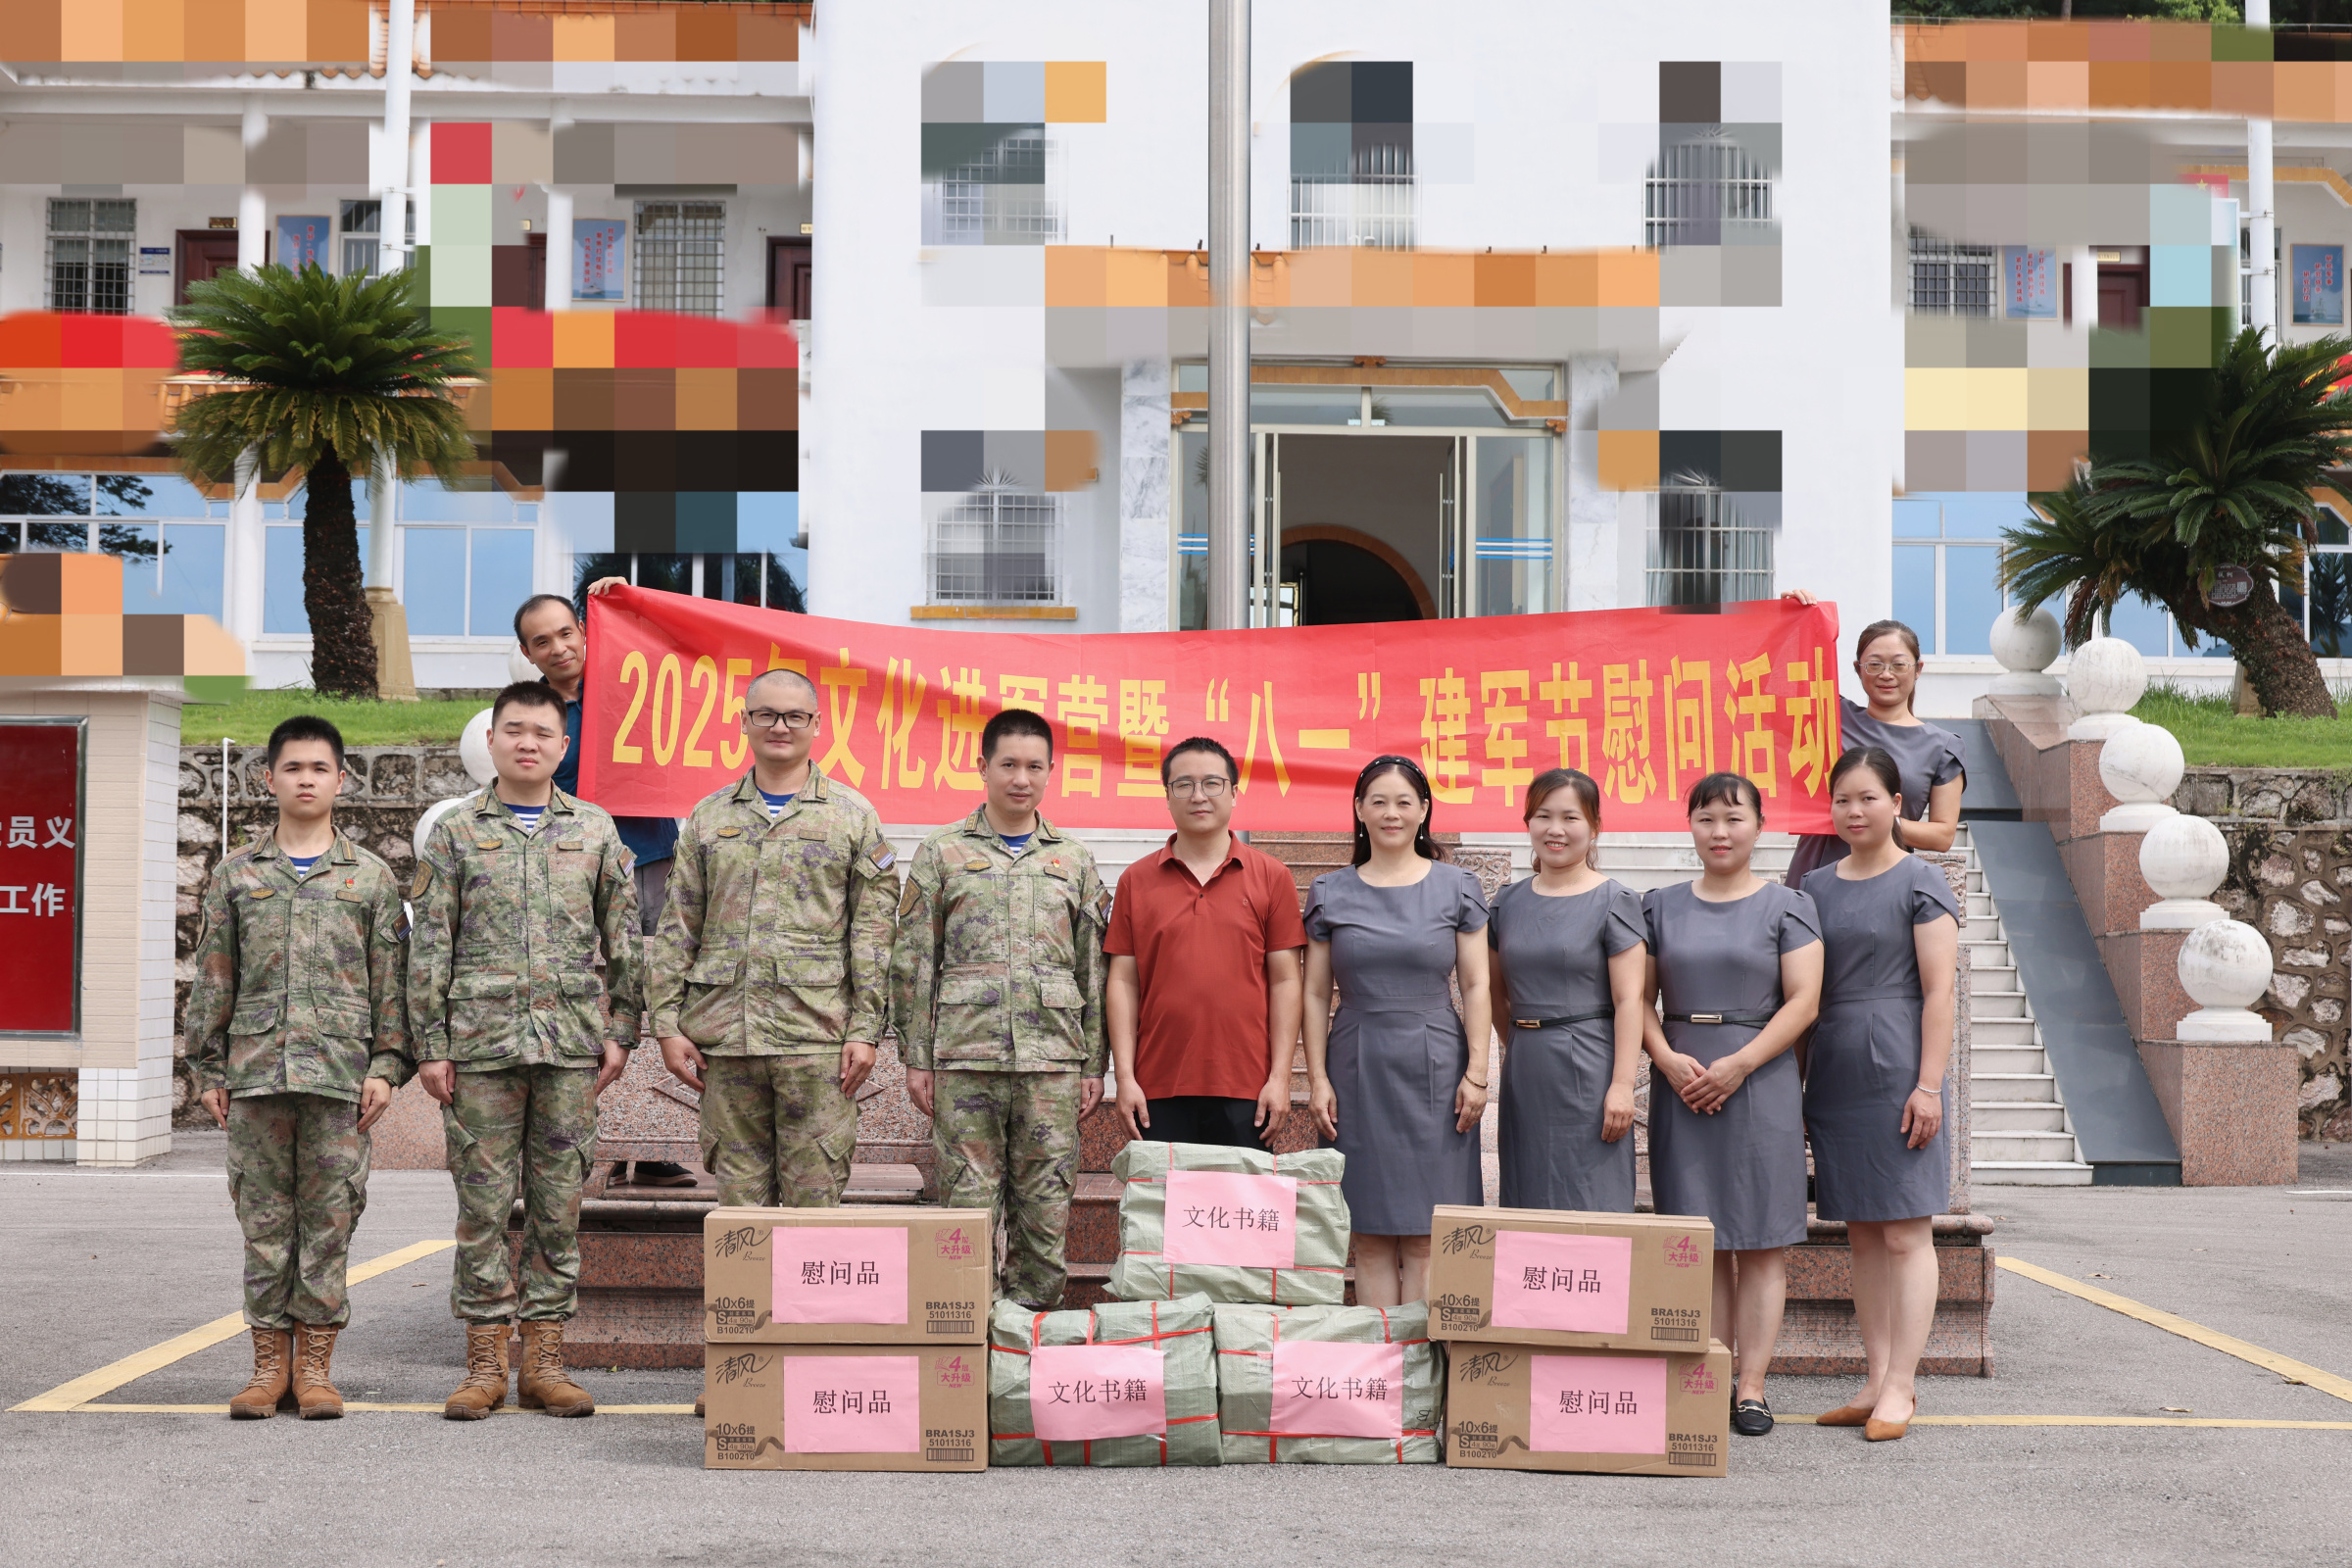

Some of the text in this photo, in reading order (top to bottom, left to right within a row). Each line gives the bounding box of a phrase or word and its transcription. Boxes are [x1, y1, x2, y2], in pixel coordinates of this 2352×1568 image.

[612, 642, 1839, 808] 2025文化进营暨“八一”建军节慰问活动
[0, 815, 75, 850] 员义
[0, 882, 74, 917] 工作
[1182, 1204, 1280, 1232] 文化书籍
[941, 1245, 971, 1254] 大升级
[1668, 1251, 1699, 1263] 大升级
[801, 1260, 879, 1286] 慰问品
[1522, 1265, 1601, 1294] 慰问品
[926, 1301, 975, 1310] BRA1SJ3
[929, 1310, 972, 1319] 51011316
[1651, 1308, 1700, 1318] BRA1SJ3
[1441, 1323, 1479, 1332] B100210
[1654, 1317, 1697, 1327] 51011316
[941, 1372, 971, 1383] 大升级
[1292, 1375, 1388, 1401] 文化书籍
[1684, 1379, 1715, 1390] 大升级
[1048, 1378, 1147, 1405] 文化书籍
[812, 1389, 891, 1414] 慰问品
[1558, 1390, 1638, 1415] 慰问品
[926, 1429, 975, 1438] BRA1SJ3
[1668, 1433, 1718, 1443] BRA1SJ3
[1671, 1443, 1714, 1451] 51011316
[1459, 1449, 1497, 1458] B100210
